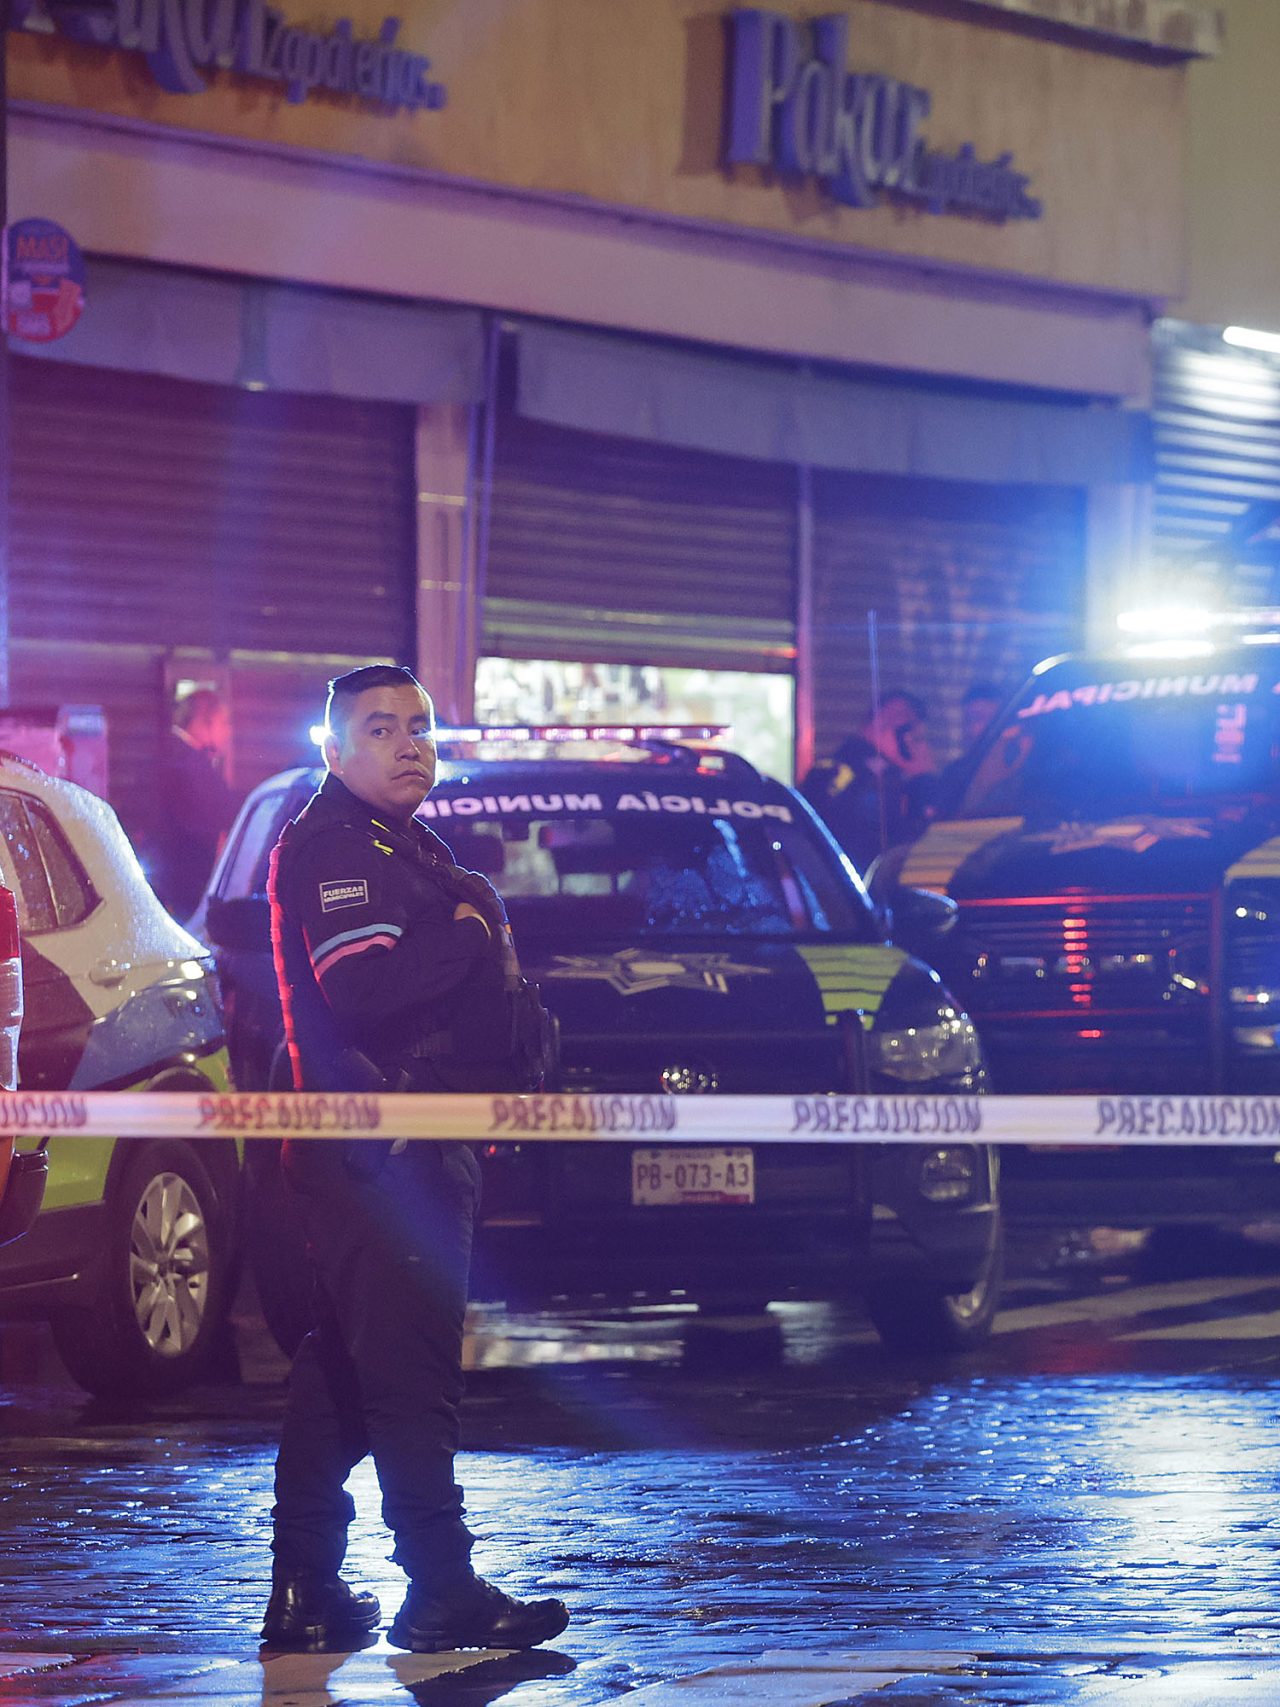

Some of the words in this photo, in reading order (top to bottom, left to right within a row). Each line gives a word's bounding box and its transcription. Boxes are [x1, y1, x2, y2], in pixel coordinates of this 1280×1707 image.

[323, 886, 364, 898] FUERZAS
[0, 1096, 87, 1128] UCION
[489, 1097, 677, 1131] PRECAUCION
[791, 1098, 982, 1133] PRECAUCION
